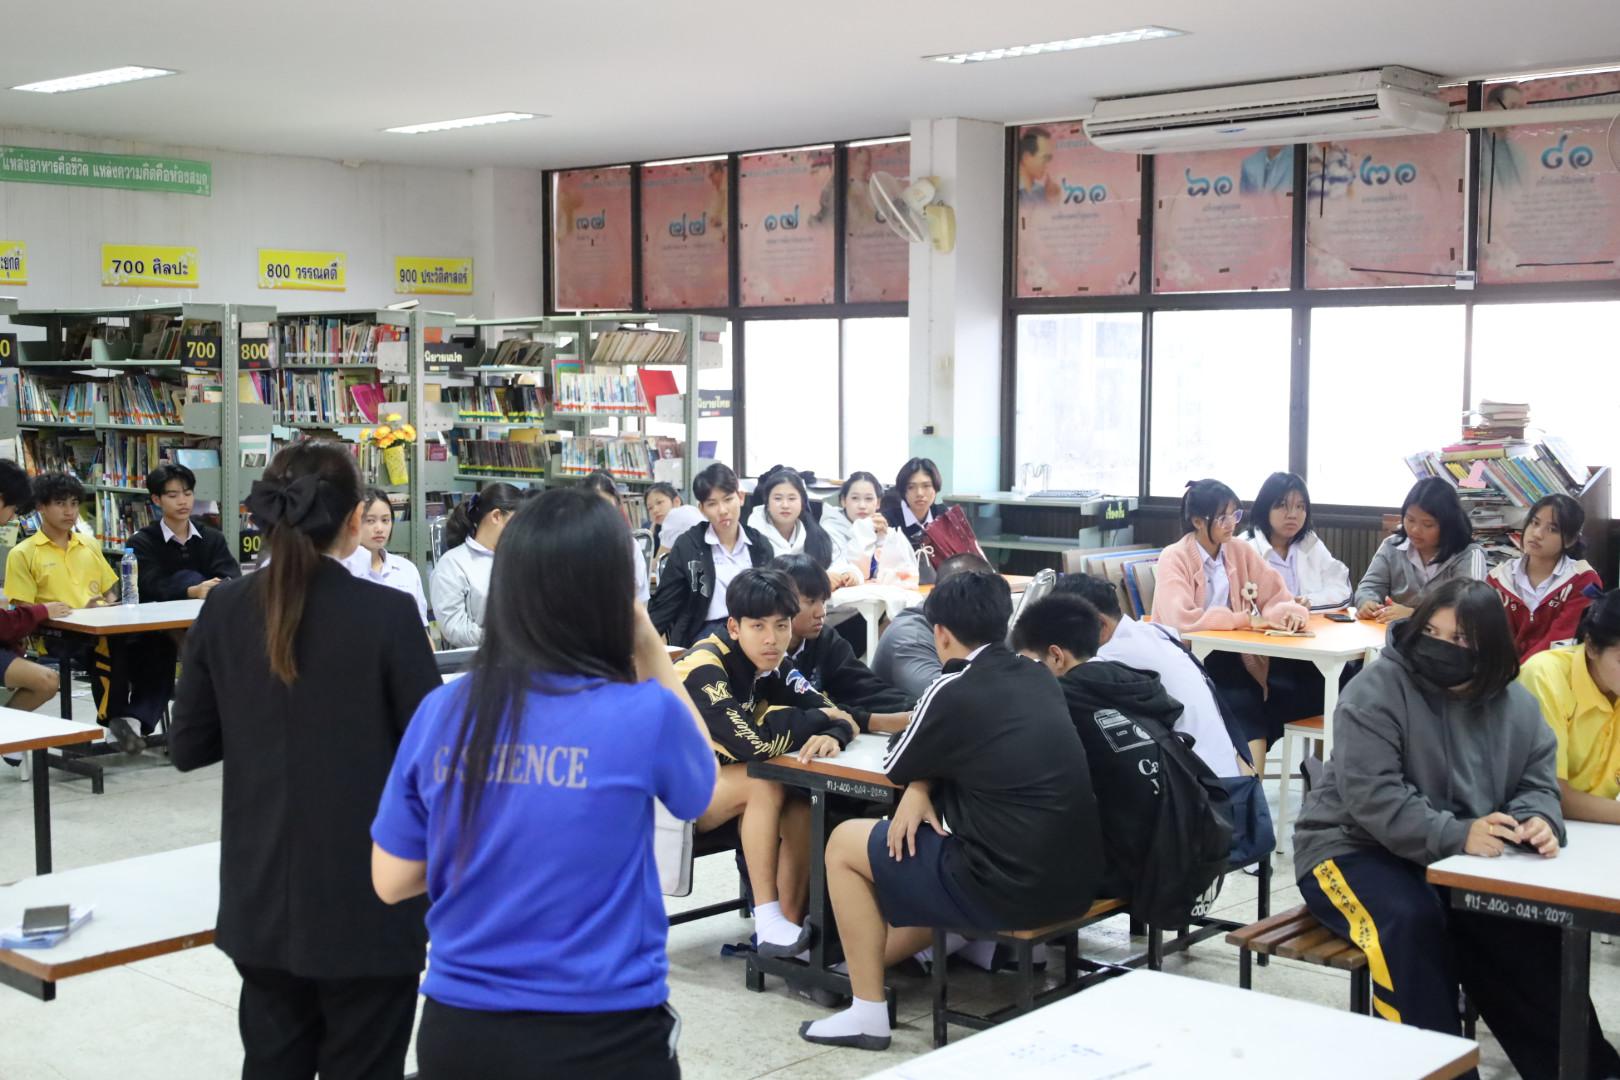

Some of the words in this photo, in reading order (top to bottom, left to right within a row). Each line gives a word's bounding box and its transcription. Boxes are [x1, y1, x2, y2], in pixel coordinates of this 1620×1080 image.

[112, 260, 145, 274] 700
[152, 258, 188, 276] ศิลปะ
[266, 263, 291, 279] 800
[399, 268, 417, 283] 900
[421, 267, 468, 285] ประวัติศาสตร์
[186, 341, 216, 359] 700
[241, 343, 269, 360] 800
[243, 535, 262, 553] 90
